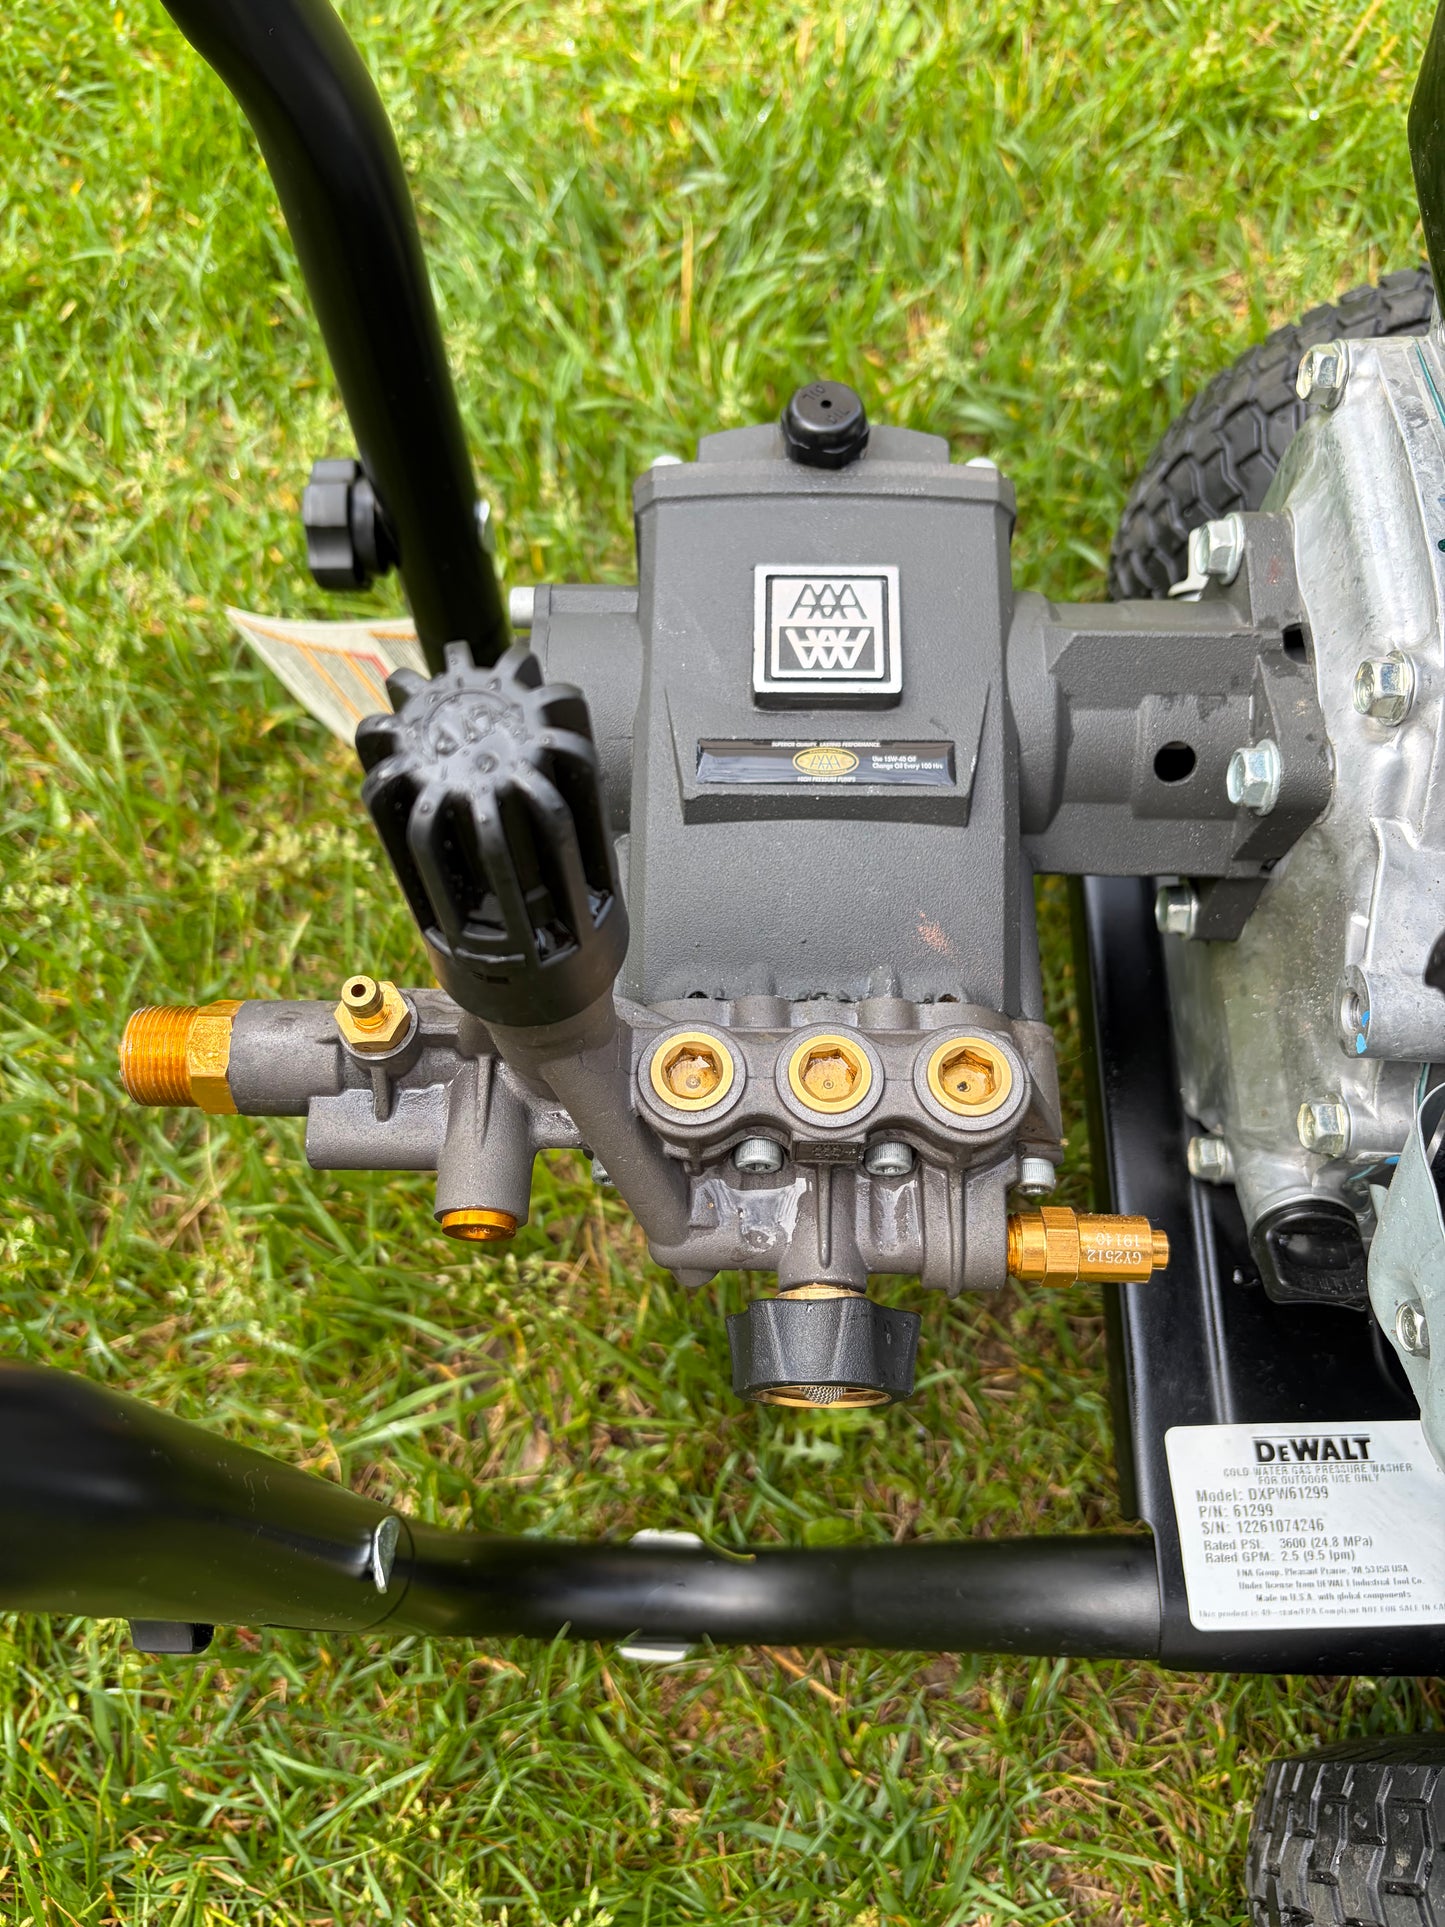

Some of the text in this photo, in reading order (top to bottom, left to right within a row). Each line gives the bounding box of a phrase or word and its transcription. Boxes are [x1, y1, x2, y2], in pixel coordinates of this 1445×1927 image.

[1087, 1249, 1142, 1264] GY2512
[1224, 1463, 1413, 1477] COLD WATER GAS PRESSURE WASHER
[1258, 1473, 1381, 1484] FOR OUTDOOR USE ONLY
[1196, 1486, 1328, 1502] Model: DXPW61299
[1198, 1504, 1274, 1518] P/N: 61299
[1201, 1518, 1325, 1535] S/N: 12261074246
[1204, 1539, 1236, 1550] Rated
[1279, 1537, 1306, 1549] 3600
[1310, 1536, 1339, 1550] (24.8
[1343, 1536, 1374, 1548] MPa)
[1205, 1552, 1238, 1564] Rated
[1281, 1550, 1300, 1561] 2.5
[1303, 1549, 1326, 1562] (9.5
[1329, 1548, 1356, 1562] lpm)
[1392, 1564, 1408, 1573] USA
[1256, 1593, 1278, 1602] Made
[1318, 1592, 1335, 1600] with
[1337, 1591, 1361, 1602] global
